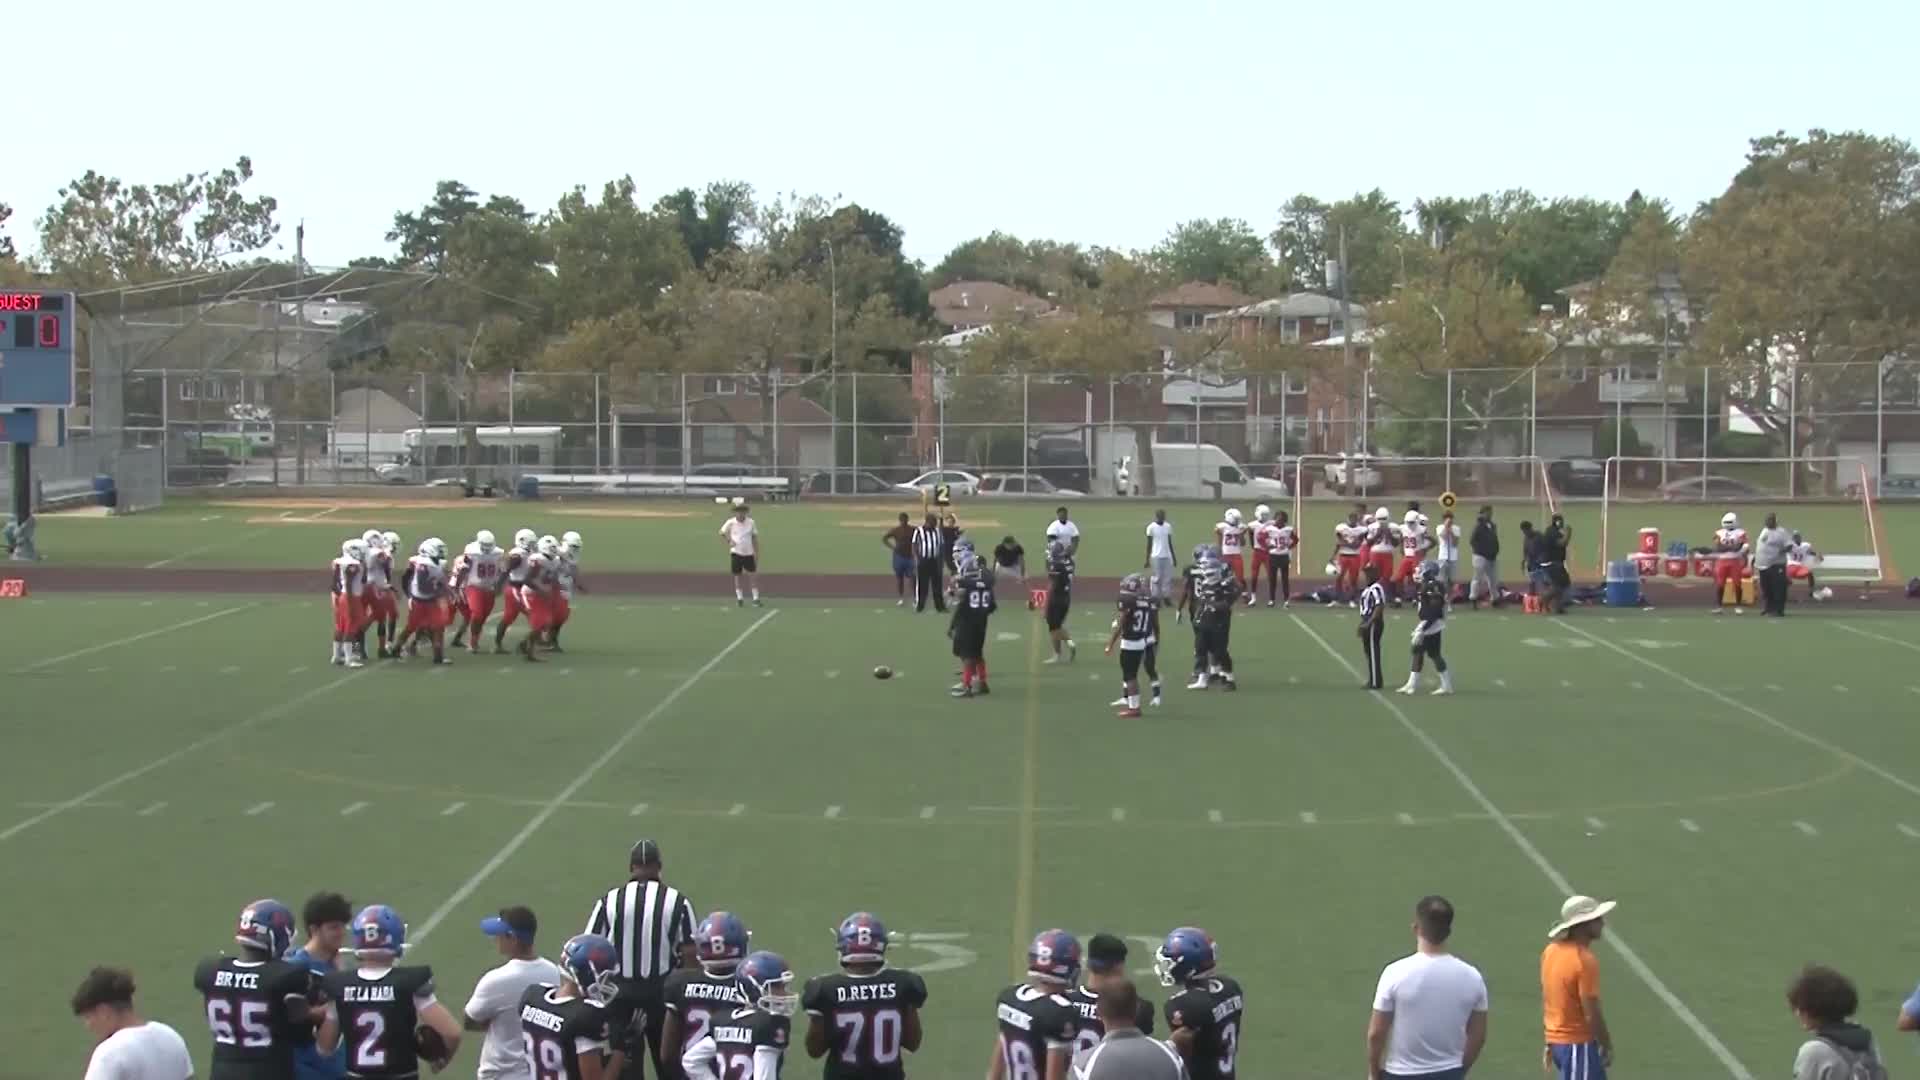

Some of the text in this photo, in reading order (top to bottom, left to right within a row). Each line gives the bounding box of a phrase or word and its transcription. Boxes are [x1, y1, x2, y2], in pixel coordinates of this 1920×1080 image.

[937, 485, 949, 501] 2
[1133, 609, 1150, 632] 31
[365, 923, 379, 942] B
[858, 927, 872, 945] B
[711, 936, 725, 954] B
[1037, 942, 1053, 966] B
[215, 971, 259, 989] BRYCE
[837, 983, 897, 1003] D.REYES
[207, 999, 272, 1047] 65
[357, 1011, 385, 1065] 2
[836, 1009, 902, 1064] 70
